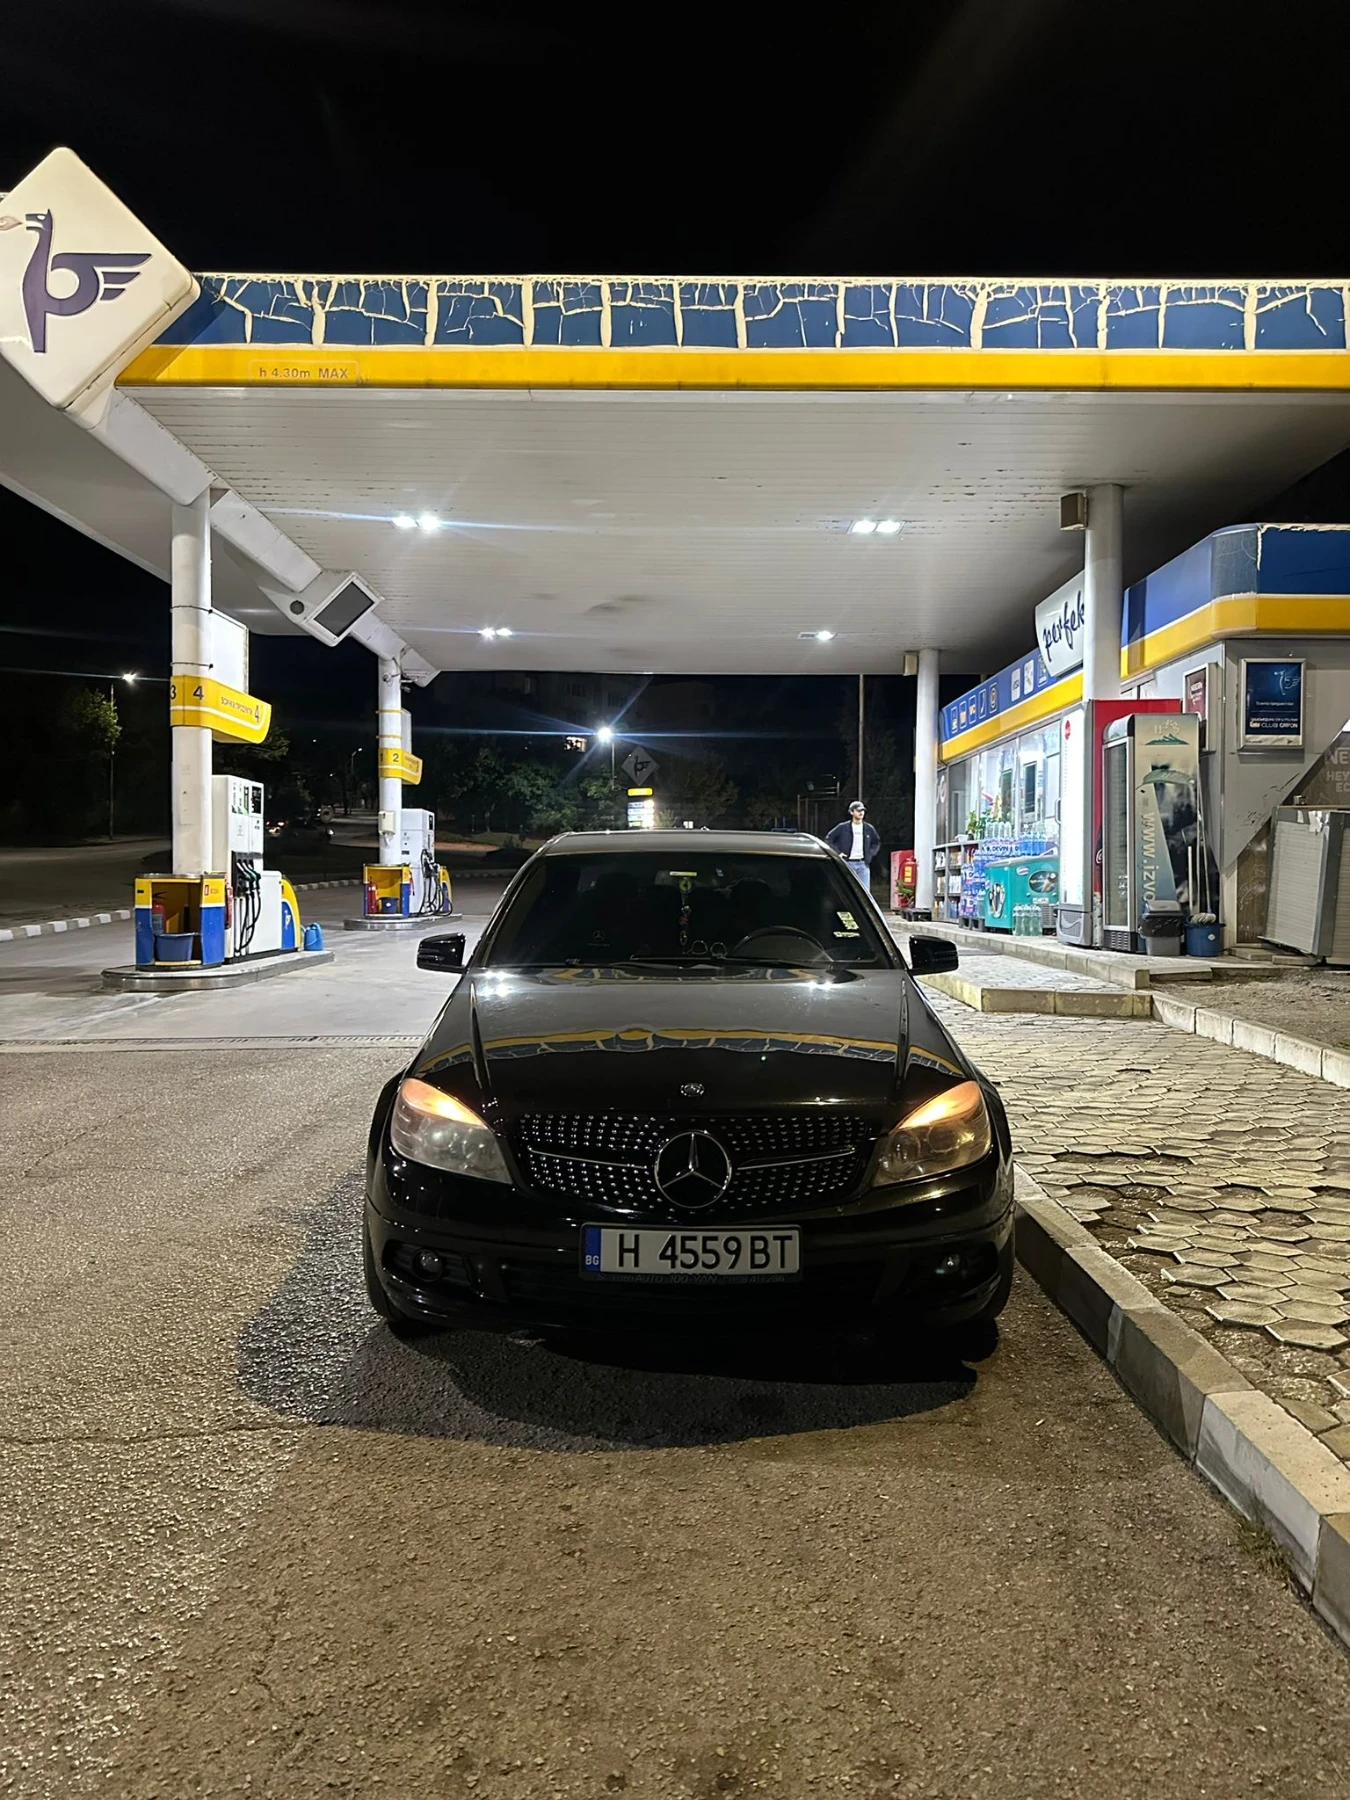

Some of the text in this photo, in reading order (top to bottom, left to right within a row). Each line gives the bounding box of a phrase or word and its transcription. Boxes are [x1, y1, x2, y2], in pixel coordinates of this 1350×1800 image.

[259, 367, 348, 378] h 4.30m MAX
[170, 685, 177, 700] 3
[193, 685, 205, 700] 4
[392, 753, 399, 762] 2
[617, 1233, 793, 1270] H 4559 BT
[585, 1254, 600, 1266] BG
